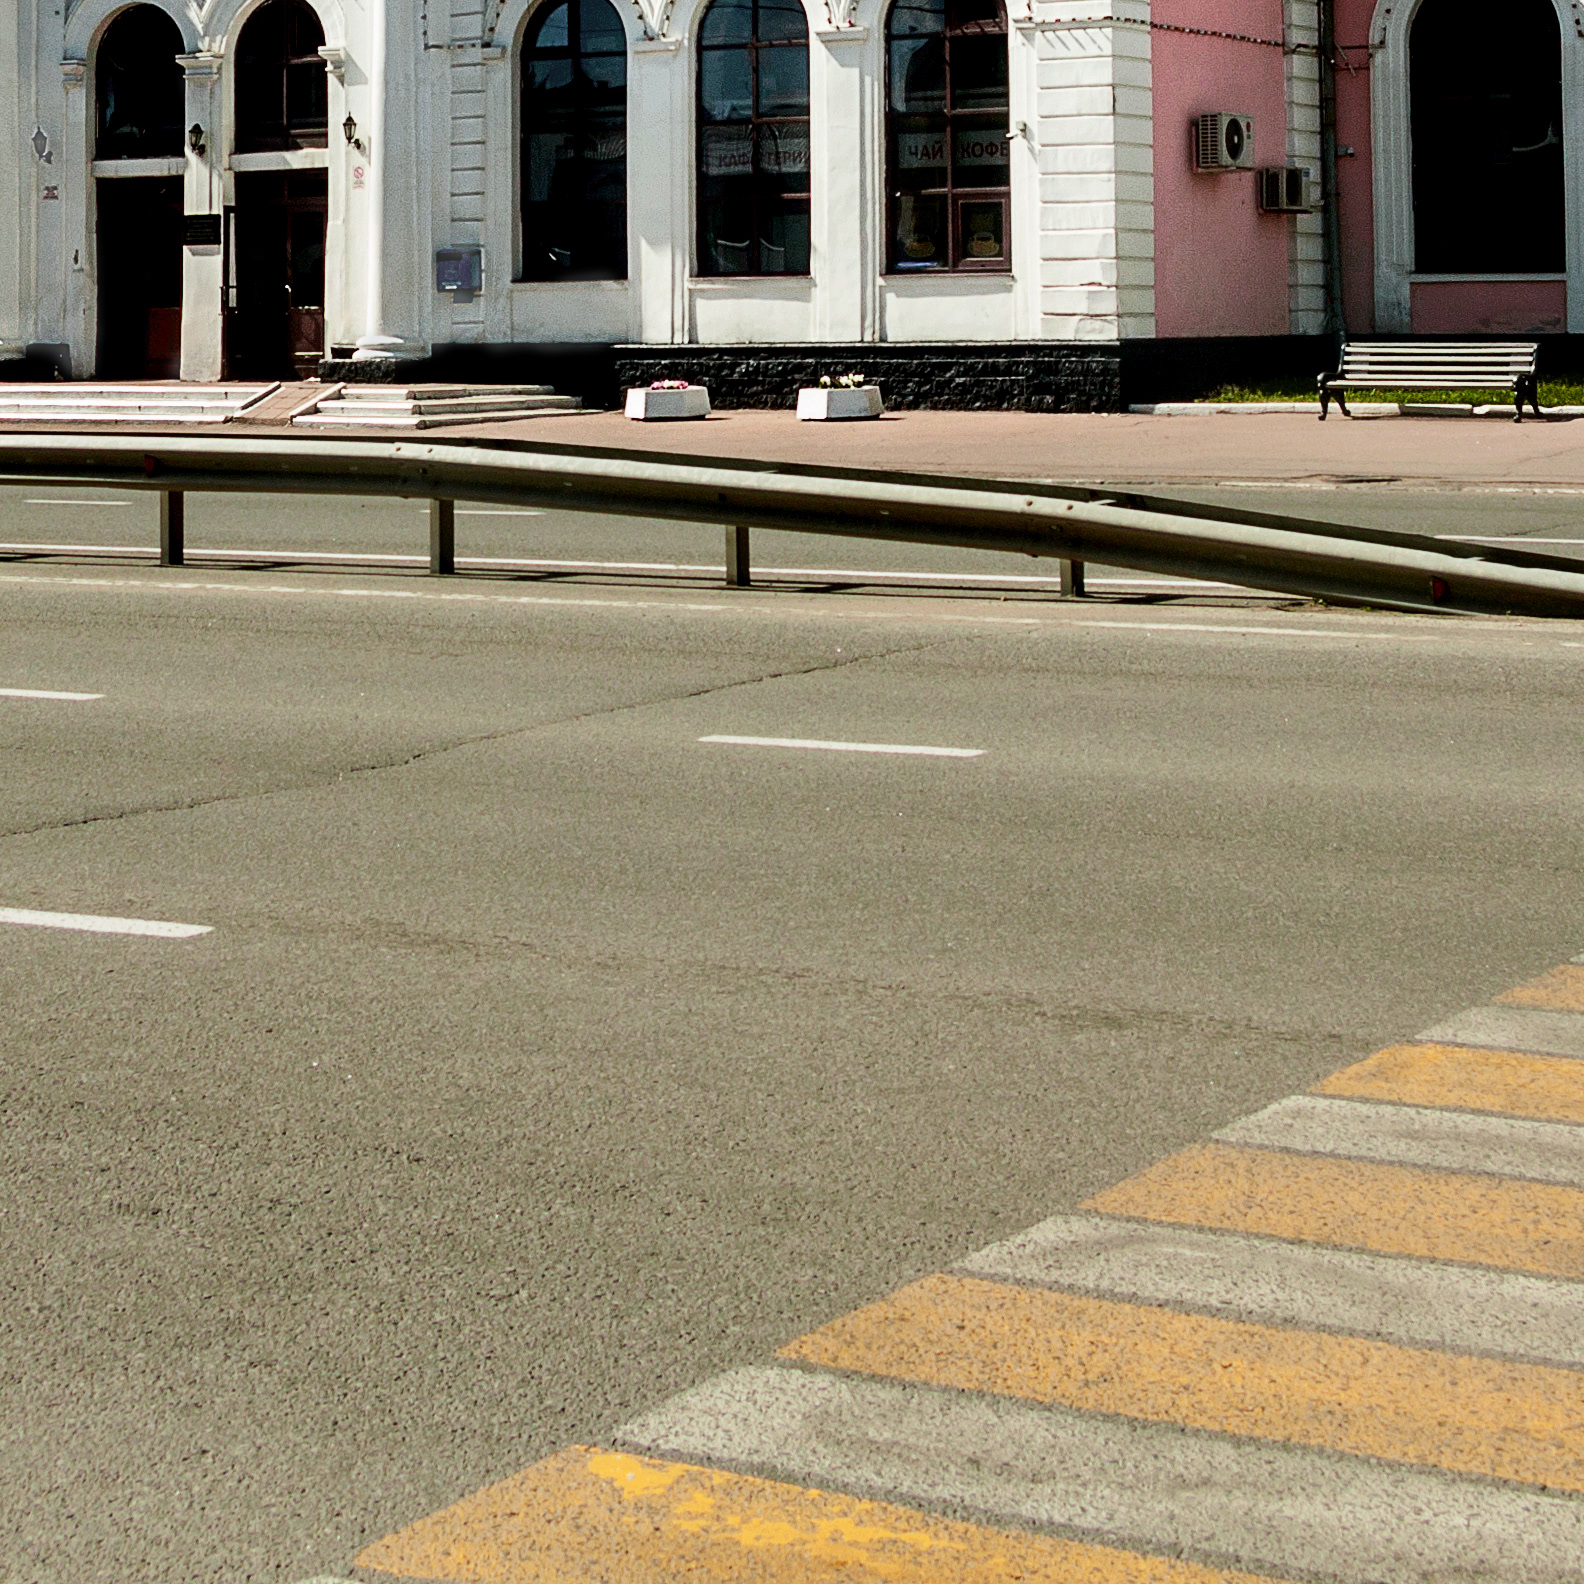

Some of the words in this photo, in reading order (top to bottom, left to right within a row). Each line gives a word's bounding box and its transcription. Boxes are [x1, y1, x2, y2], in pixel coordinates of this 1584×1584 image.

[719, 149, 810, 167] КАФТЕРИ
[908, 141, 944, 161] ЧАЙ
[960, 142, 1009, 160] КОФЕ
